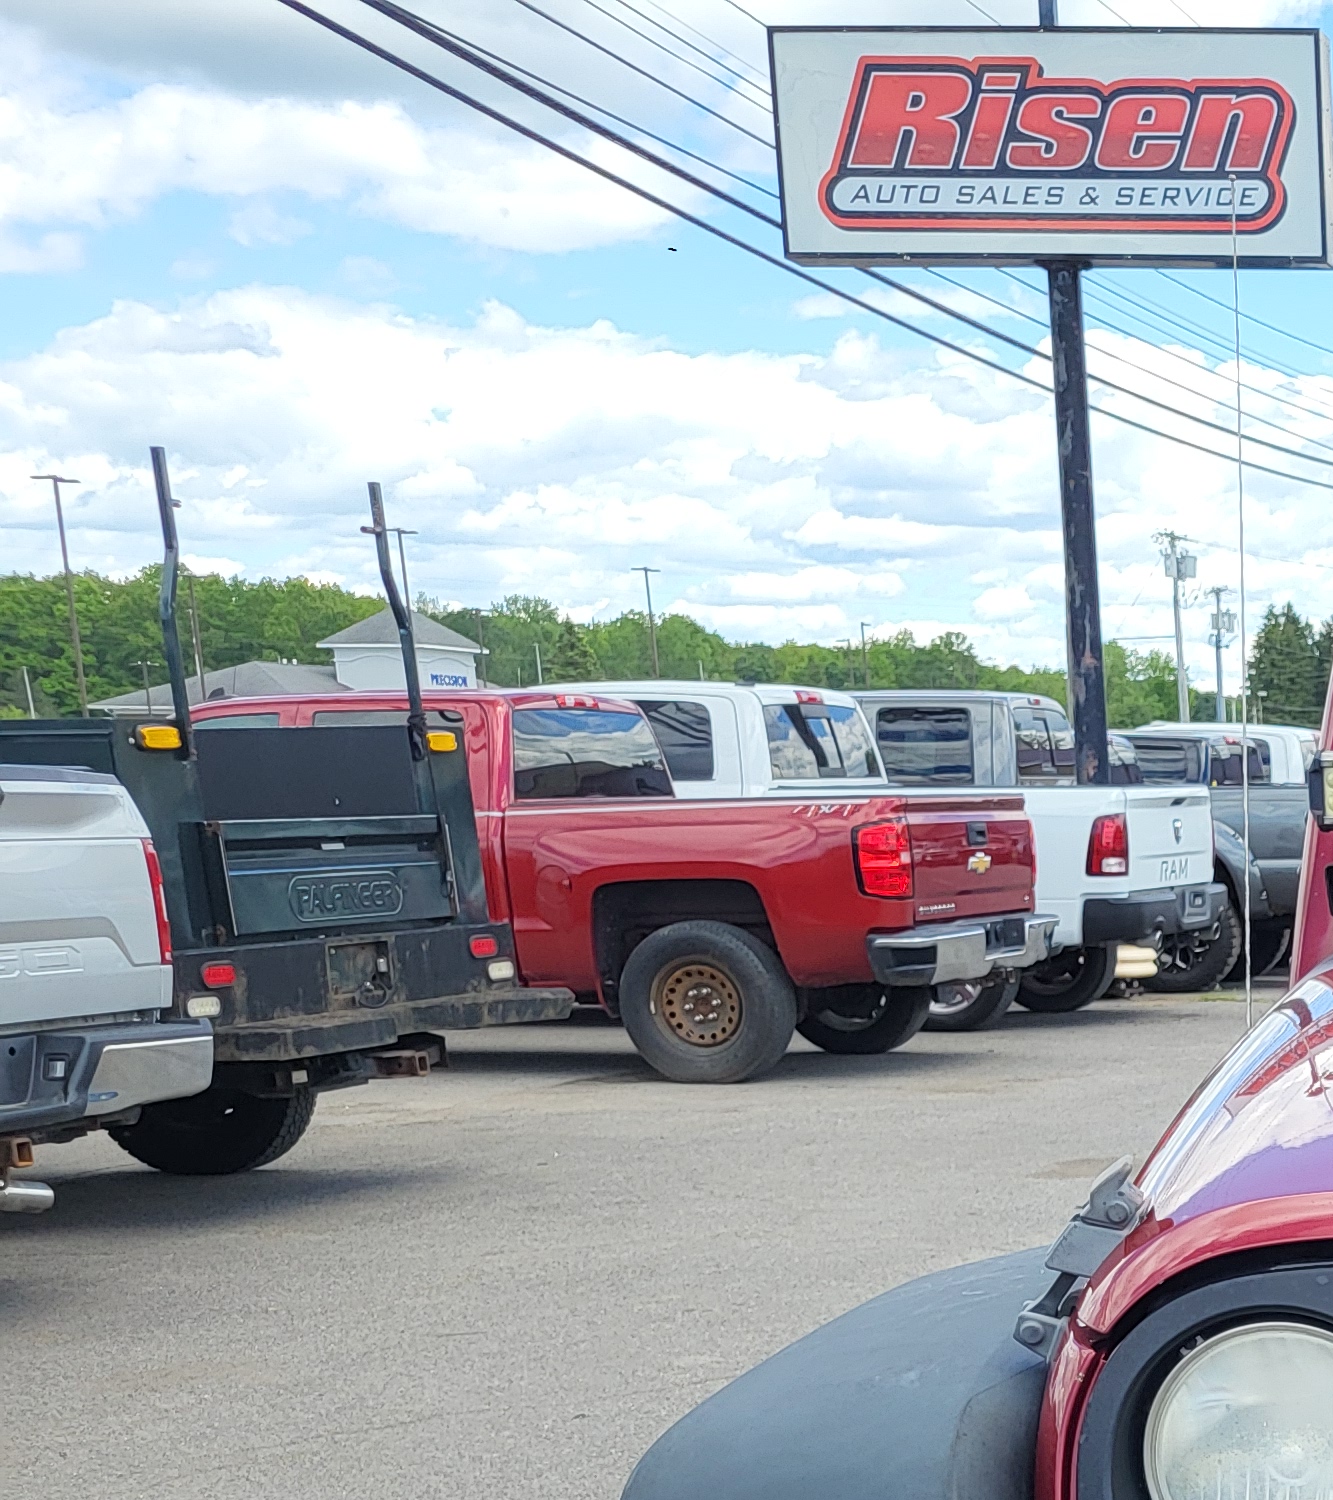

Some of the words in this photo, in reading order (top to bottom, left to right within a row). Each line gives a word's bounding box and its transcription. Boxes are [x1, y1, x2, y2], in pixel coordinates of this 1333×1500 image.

[847, 70, 1280, 172] Risen
[850, 183, 940, 204] AUTO
[955, 184, 1065, 206] SALES
[1078, 185, 1100, 206] &
[1114, 186, 1259, 208] SERVICE
[1160, 857, 1188, 882] RAM
